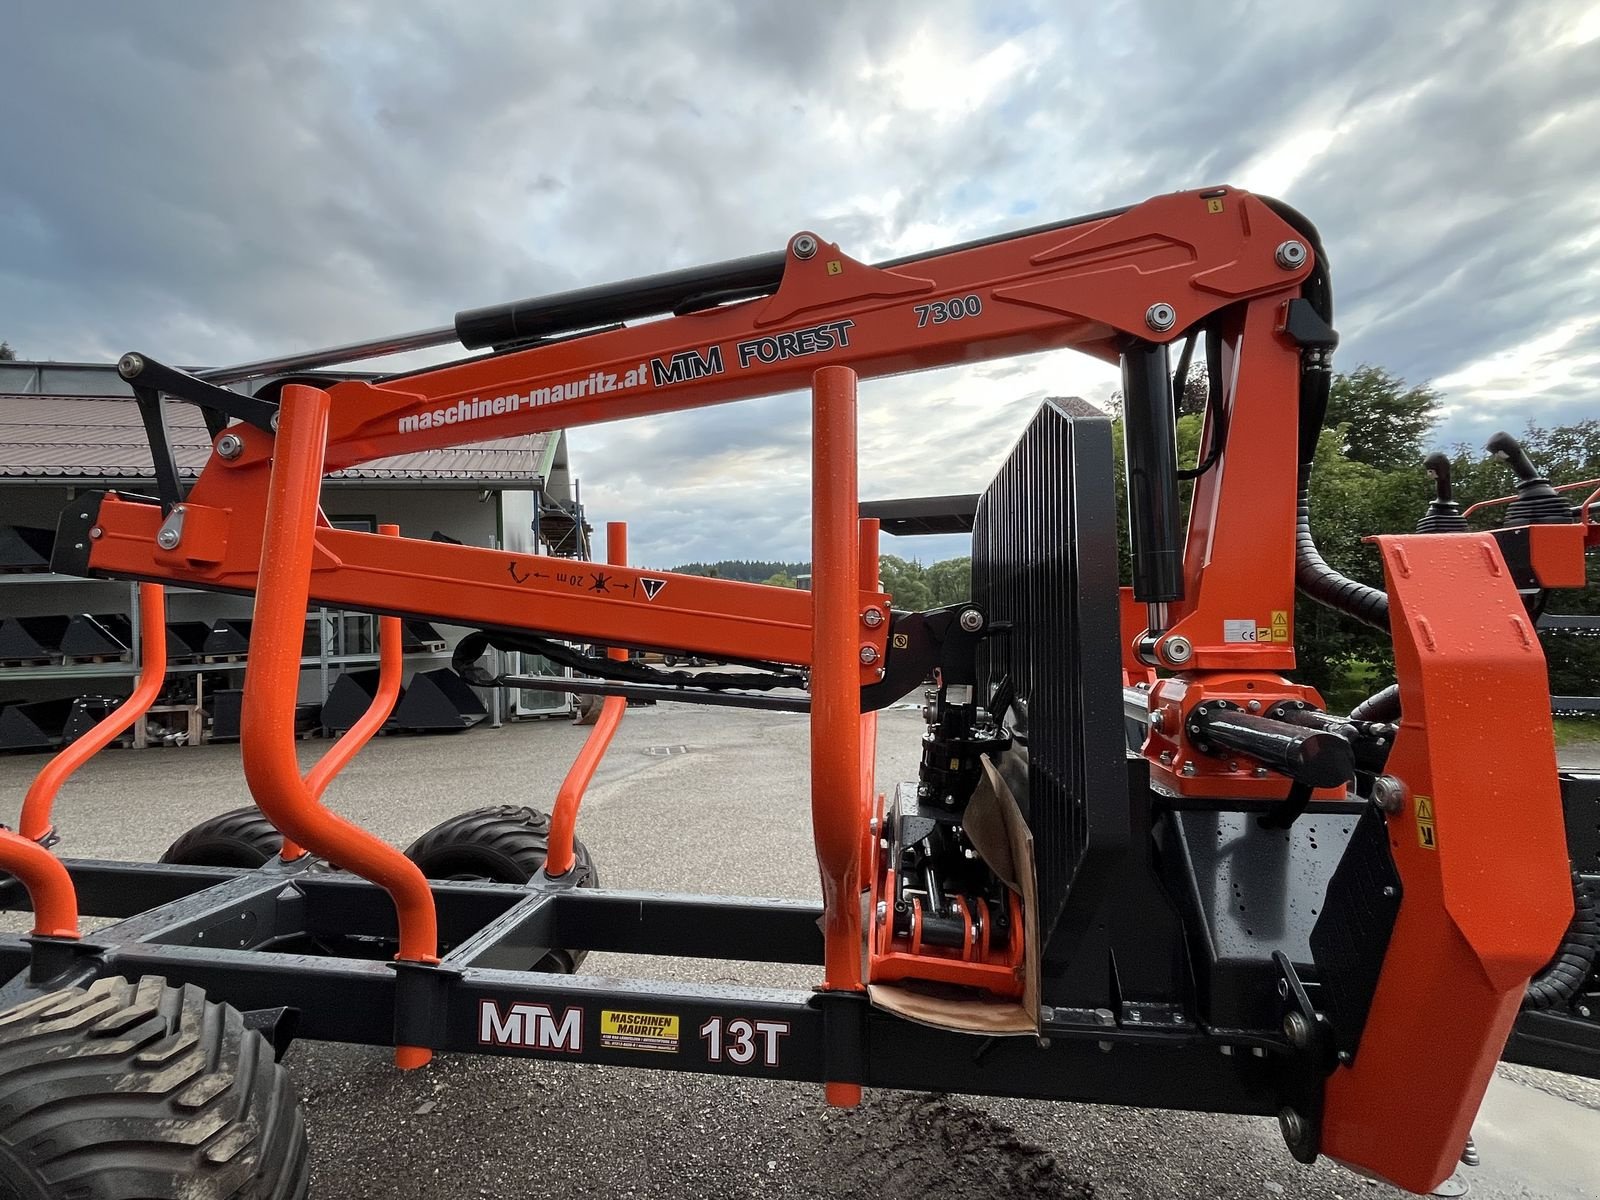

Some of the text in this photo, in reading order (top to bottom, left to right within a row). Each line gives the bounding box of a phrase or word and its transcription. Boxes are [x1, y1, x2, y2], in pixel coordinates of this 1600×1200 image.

[913, 295, 982, 328] 7300
[650, 319, 855, 387] MTM FOREST
[398, 363, 648, 434] maschinen-mauritz.at
[556, 572, 583, 587] 20 m
[479, 1000, 584, 1053] MTM
[610, 1013, 672, 1027] MASCHINEN
[617, 1024, 664, 1036] MAURITZ
[700, 1016, 789, 1067] 13T
